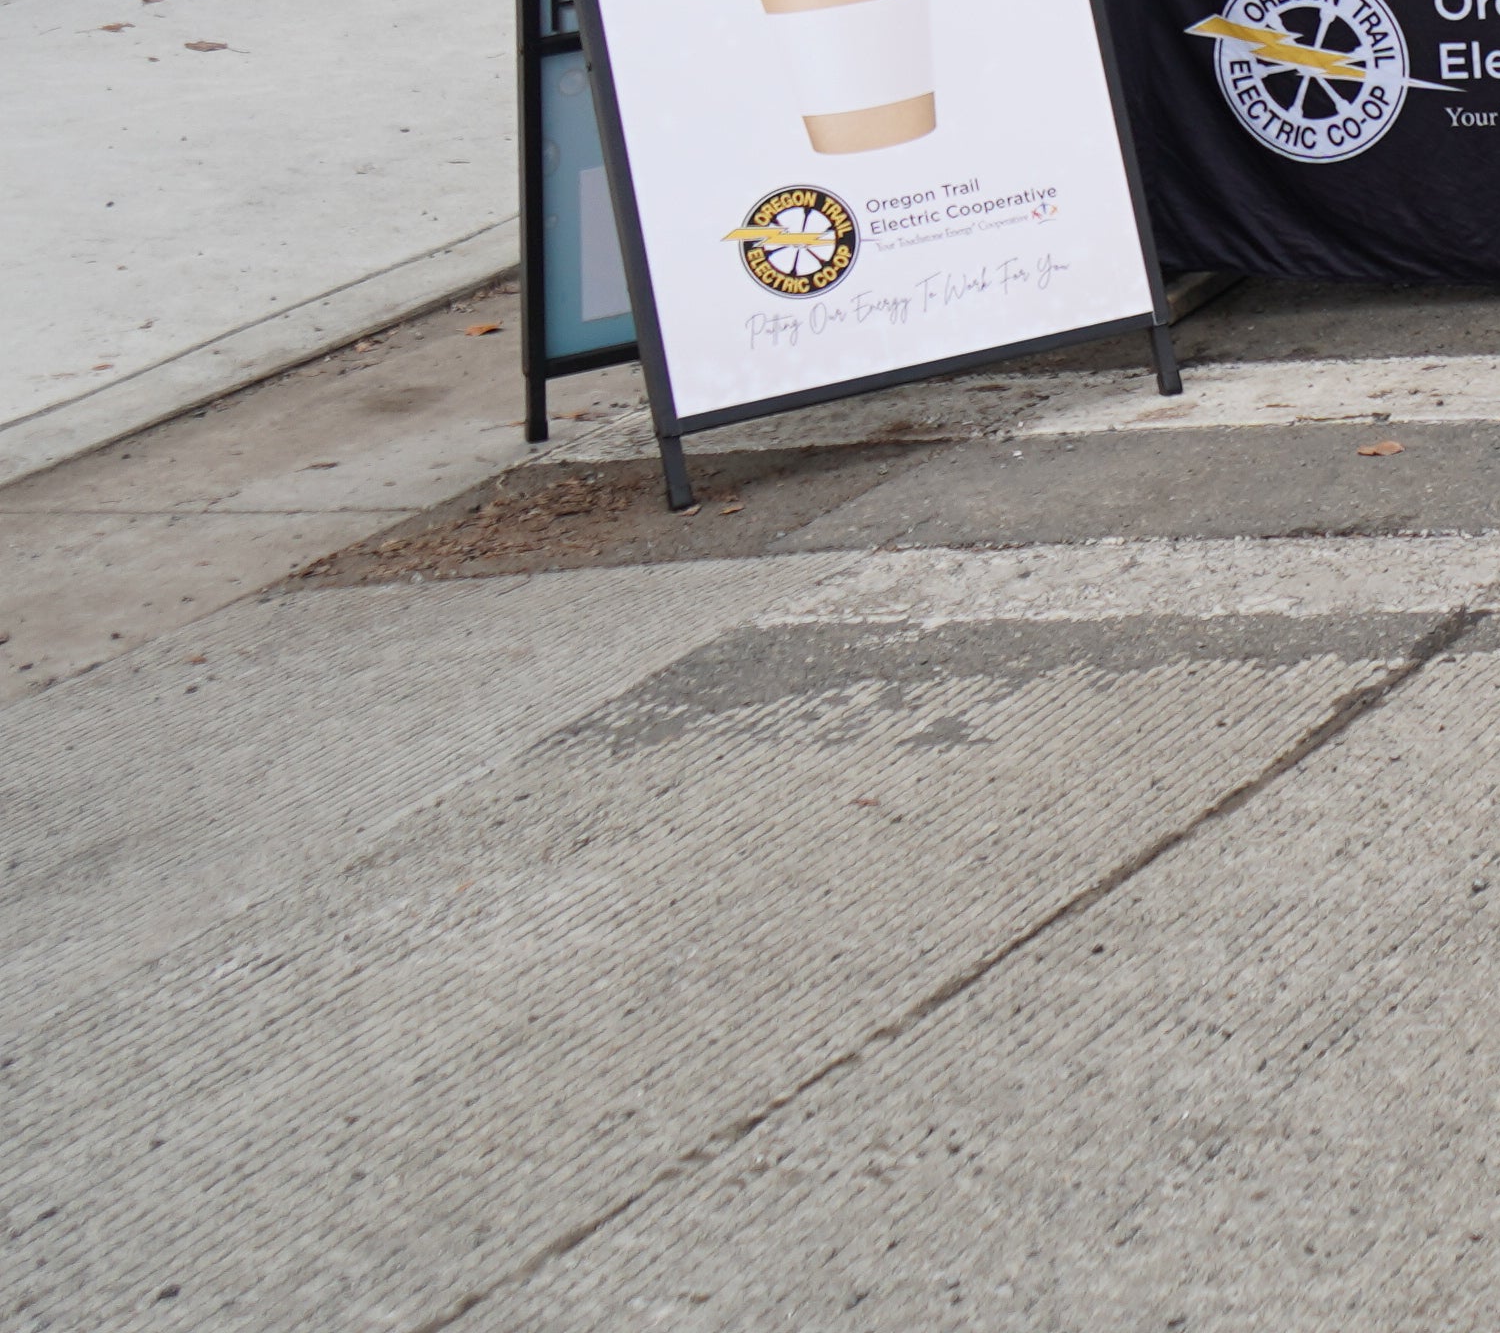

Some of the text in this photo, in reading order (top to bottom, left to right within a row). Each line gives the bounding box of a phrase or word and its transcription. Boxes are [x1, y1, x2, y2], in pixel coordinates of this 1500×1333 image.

[1228, 59, 1392, 151] ELECTRIC CO-OP
[1444, 104, 1500, 129] Your
[754, 190, 854, 239] OREGON TRAIL
[866, 178, 981, 215] Oregon Trail
[869, 184, 1058, 236] Electric Cooperative
[747, 244, 853, 295] ELECTRIC CO-OP
[744, 311, 804, 351] Putting
[808, 301, 848, 335] Our
[850, 290, 913, 325] Energy
[915, 271, 942, 313] To
[943, 267, 992, 307] Work
[1036, 252, 1071, 288] You
